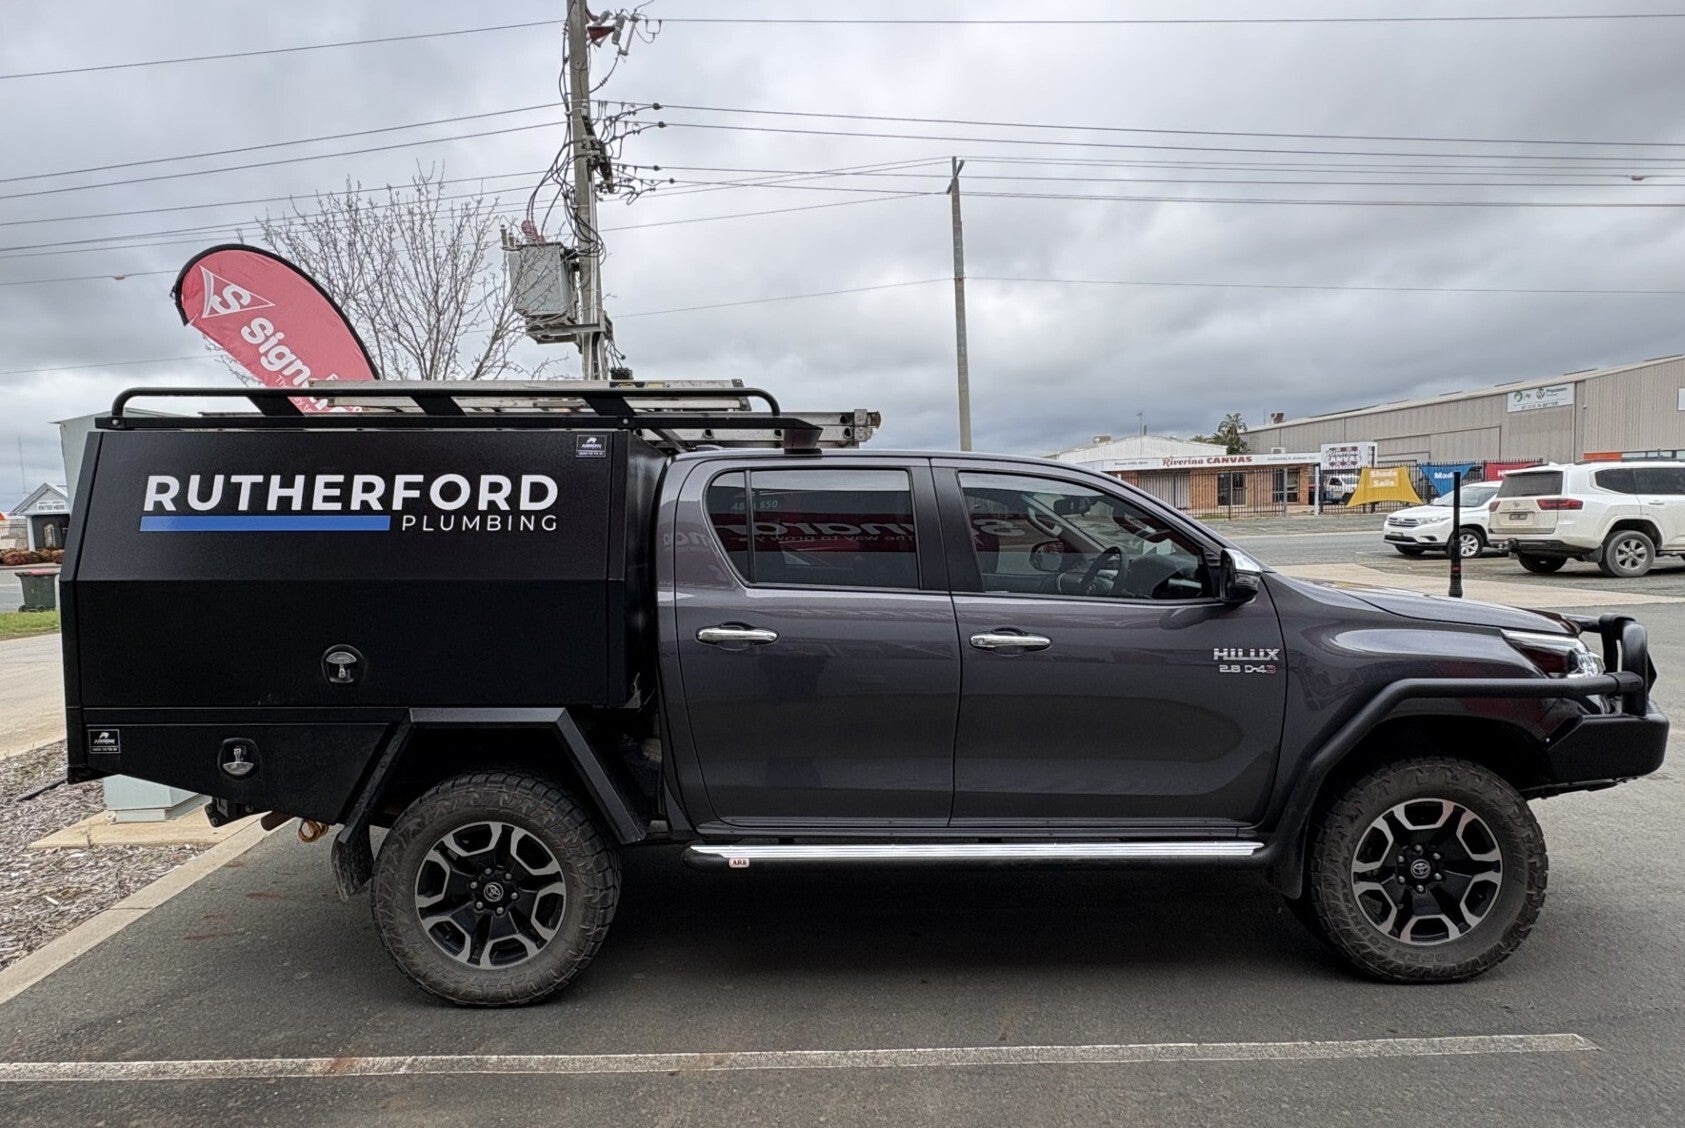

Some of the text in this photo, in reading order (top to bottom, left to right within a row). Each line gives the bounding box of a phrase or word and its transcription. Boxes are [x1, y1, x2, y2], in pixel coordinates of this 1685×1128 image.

[1162, 455, 1253, 467] Riverina CANVAS
[1434, 471, 1455, 479] Mad
[143, 473, 559, 511] RUTHERFORD
[402, 514, 558, 532] PLUMBING
[1213, 647, 1280, 661] HILUX
